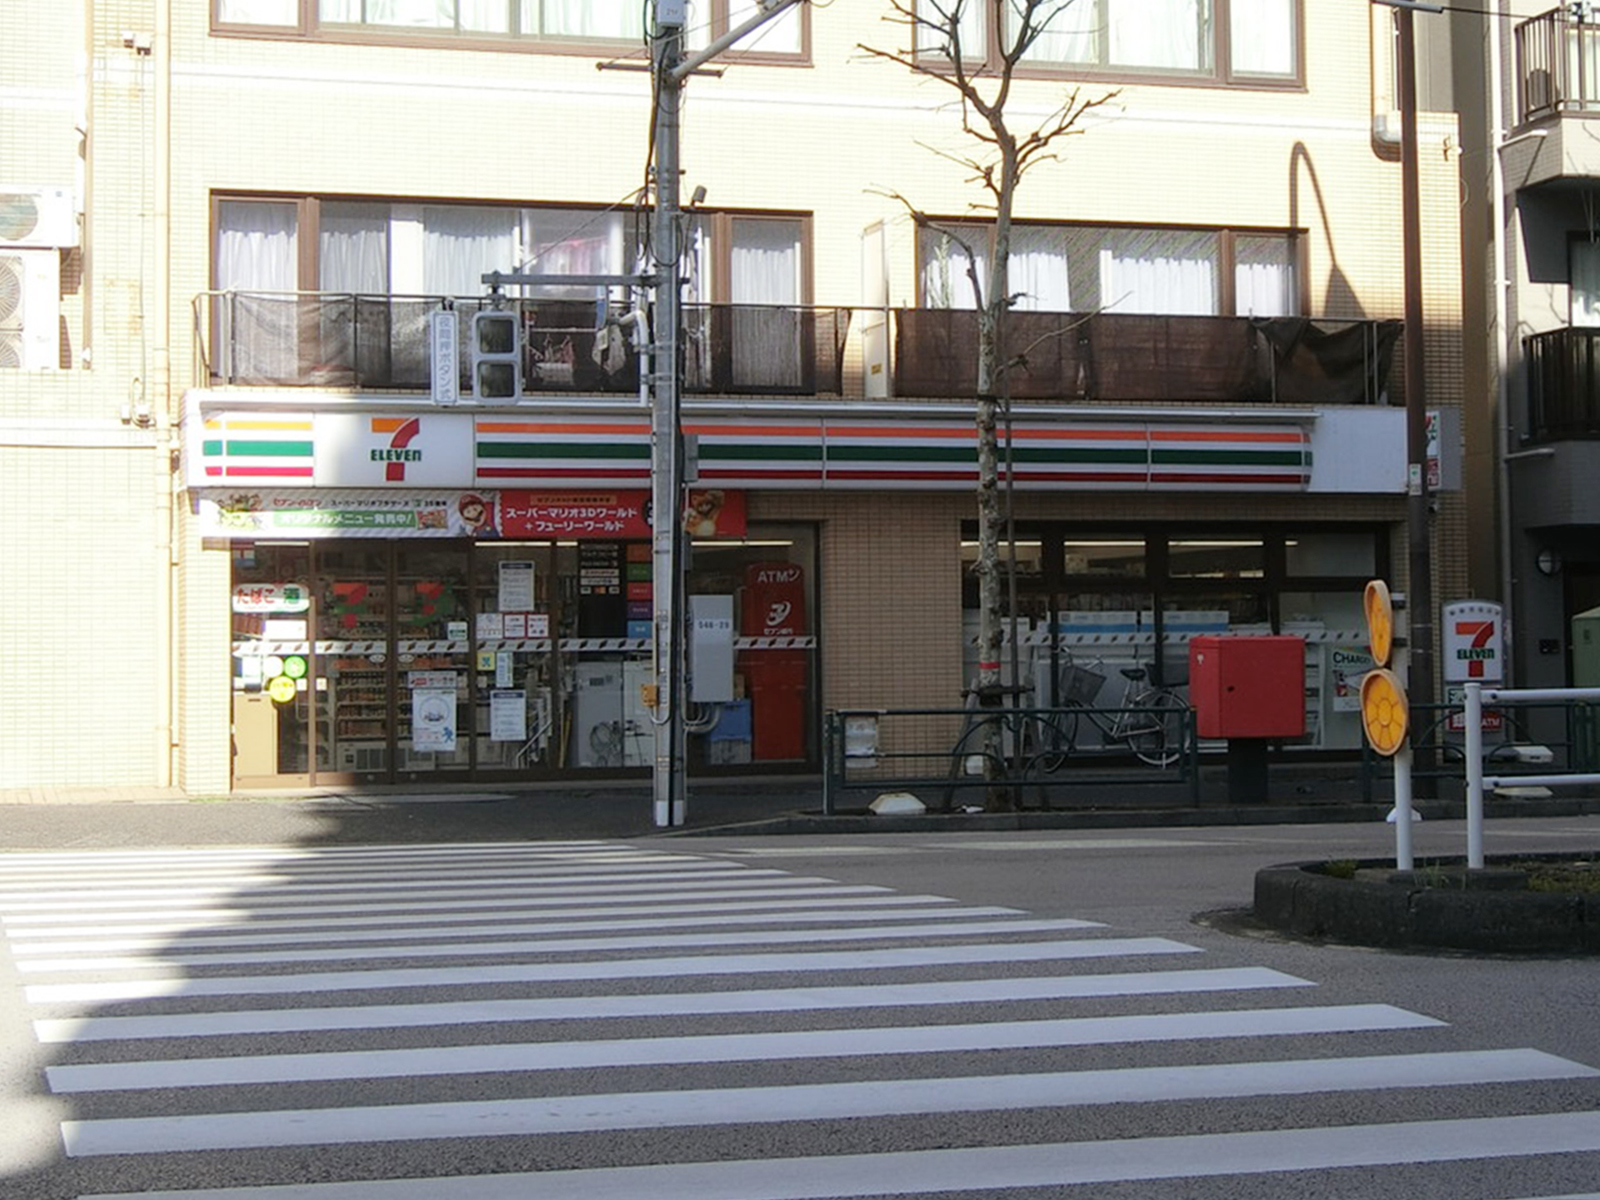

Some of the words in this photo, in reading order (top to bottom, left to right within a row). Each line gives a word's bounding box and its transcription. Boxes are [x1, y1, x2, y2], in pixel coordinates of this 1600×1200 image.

[371, 417, 420, 482] 7
[236, 587, 277, 605] たばこ
[282, 586, 300, 606] 酒
[758, 570, 789, 584] ATM
[1455, 620, 1495, 678] 7
